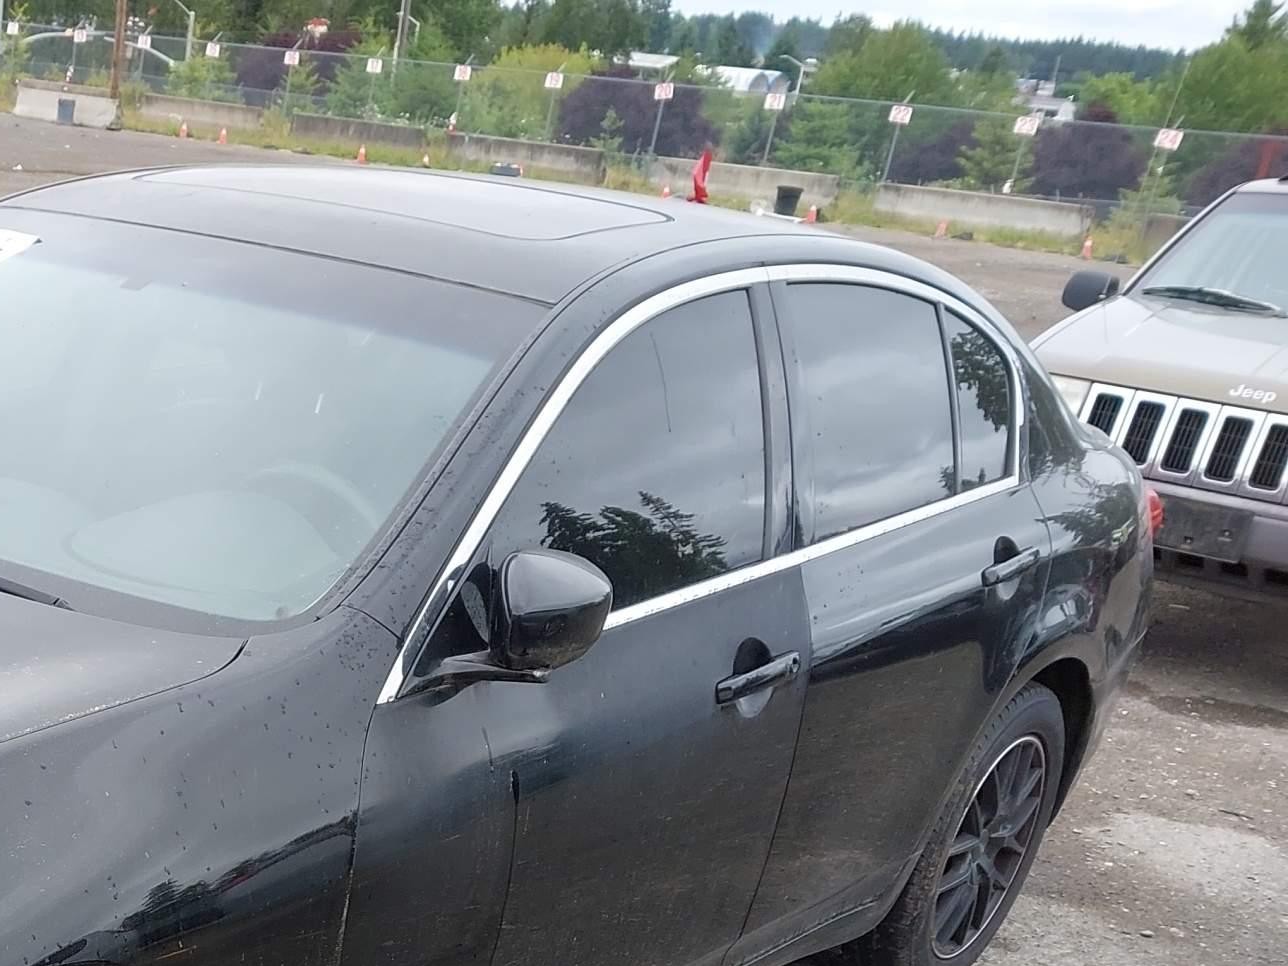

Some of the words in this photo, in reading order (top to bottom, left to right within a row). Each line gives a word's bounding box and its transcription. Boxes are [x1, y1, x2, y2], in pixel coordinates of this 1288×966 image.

[657, 84, 672, 98] 20
[769, 94, 781, 108] 21
[892, 106, 909, 122] 22
[1017, 117, 1036, 134] 23
[1161, 130, 1179, 148] 24
[1229, 383, 1277, 403] Jeep
